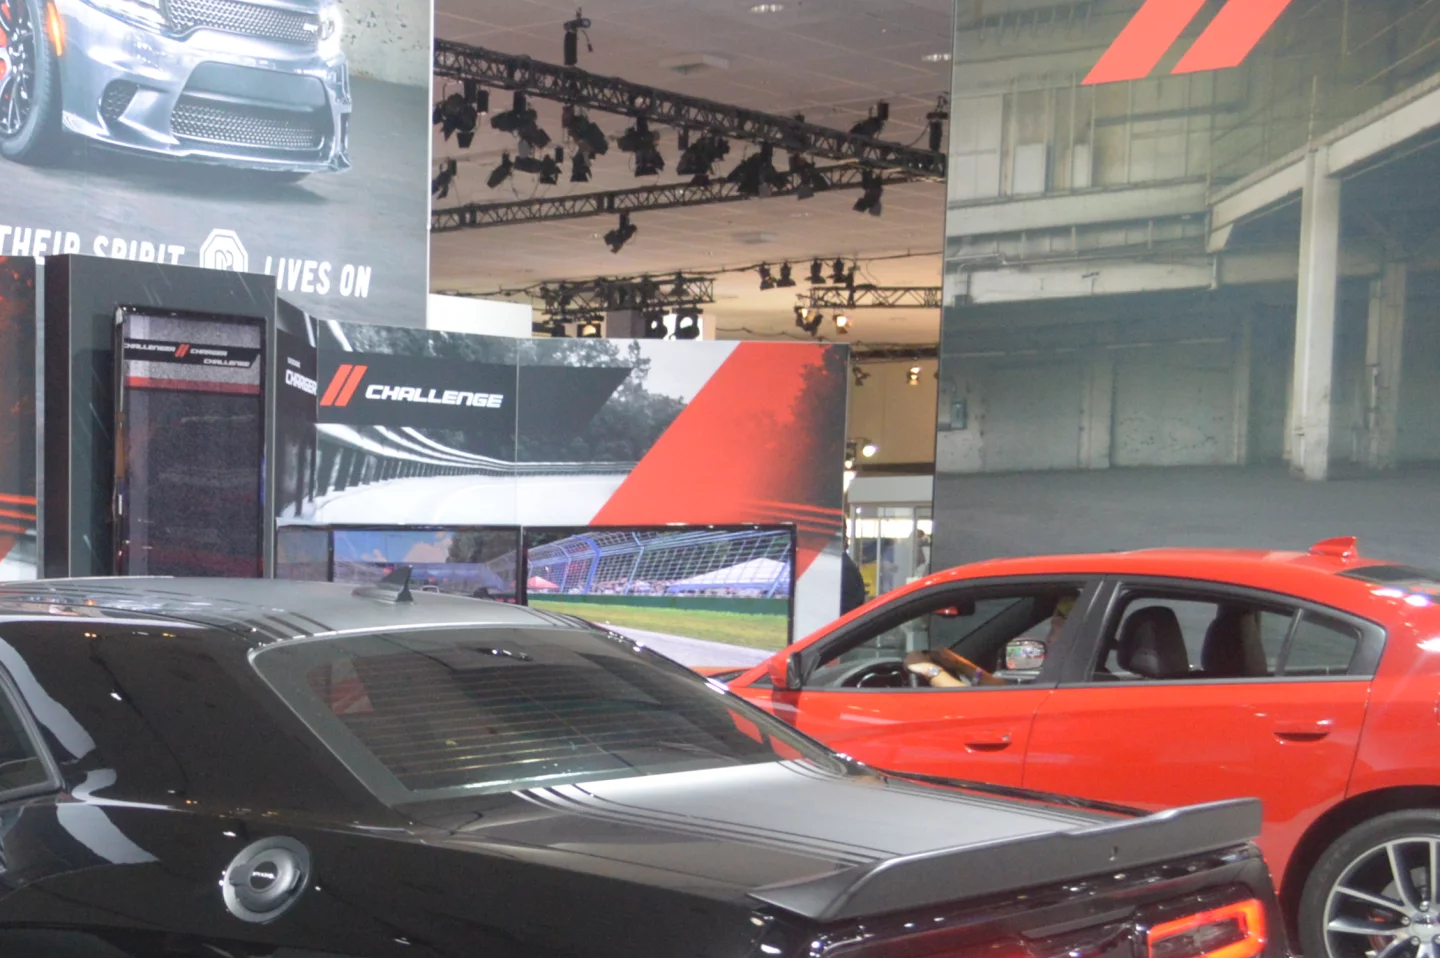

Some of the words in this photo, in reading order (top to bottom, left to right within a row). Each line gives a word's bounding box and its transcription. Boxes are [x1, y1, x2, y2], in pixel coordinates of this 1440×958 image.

[93, 235, 185, 266] SPIRIT
[339, 264, 372, 298] ON
[190, 347, 228, 357] CHARGER
[203, 358, 251, 368] CHALLENGE
[364, 384, 504, 409] CHALLENGE
